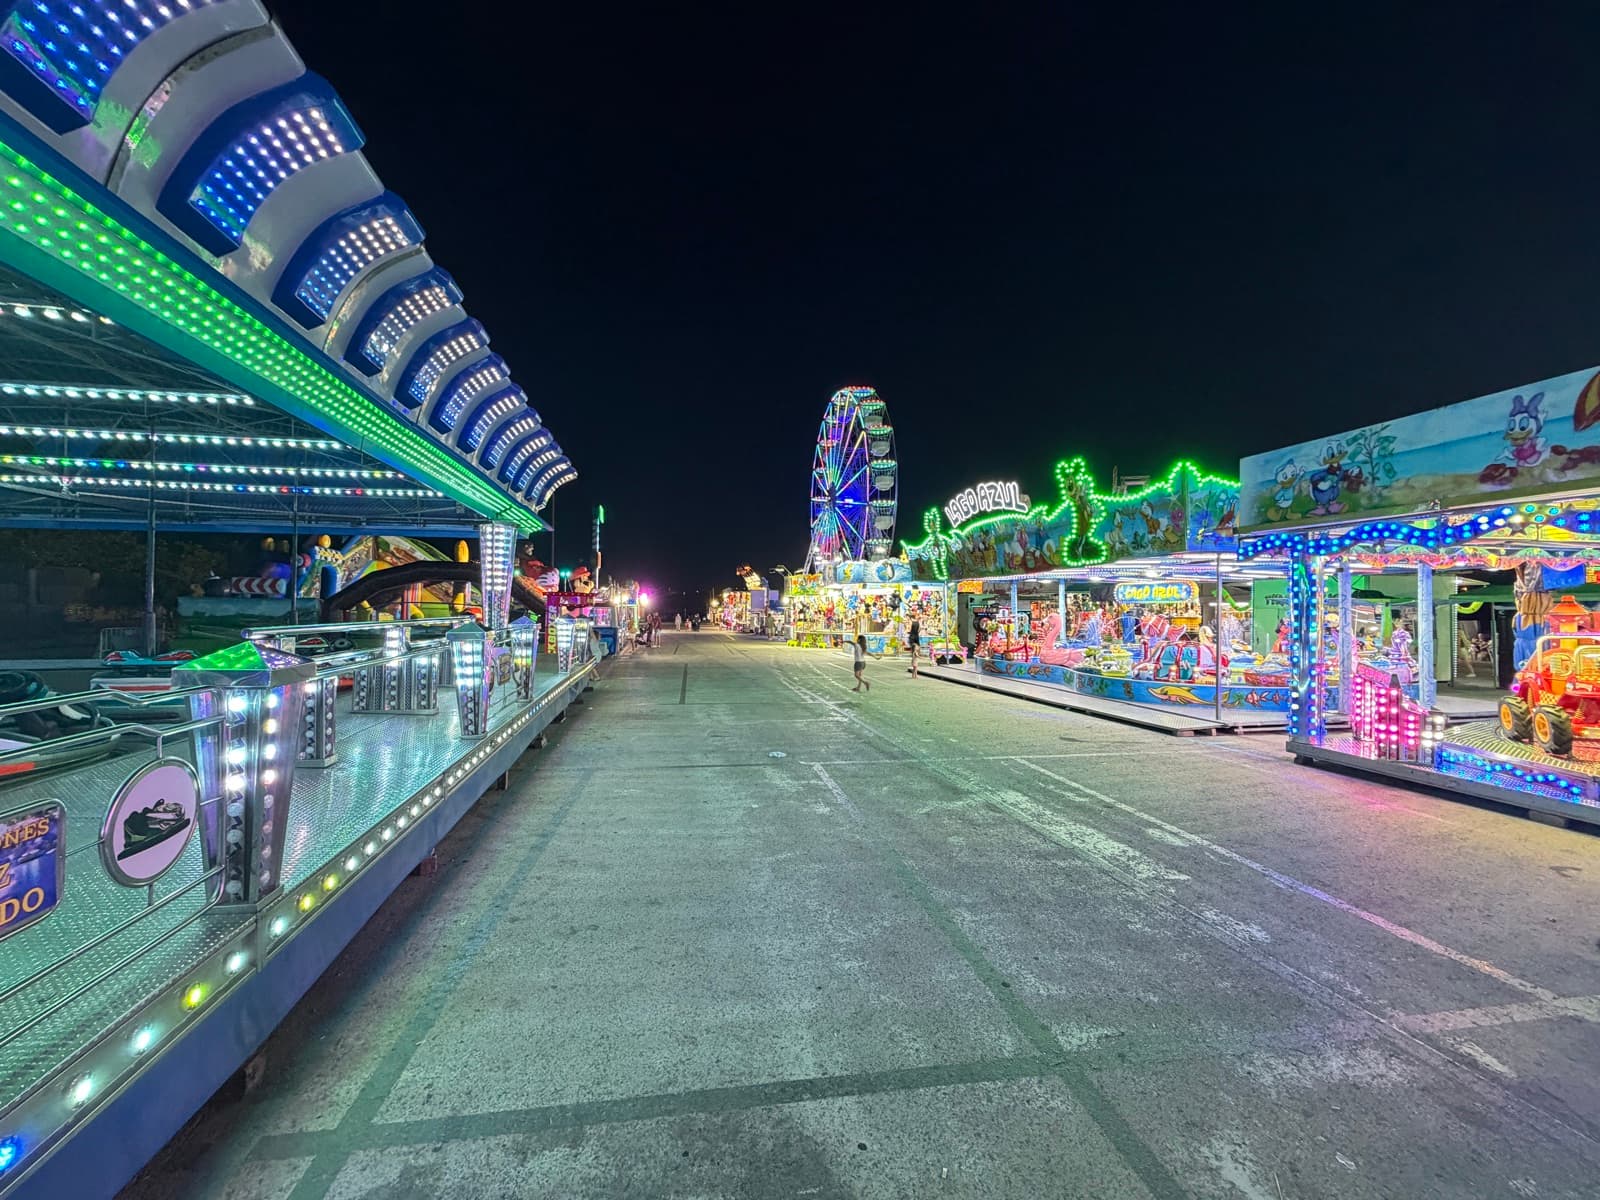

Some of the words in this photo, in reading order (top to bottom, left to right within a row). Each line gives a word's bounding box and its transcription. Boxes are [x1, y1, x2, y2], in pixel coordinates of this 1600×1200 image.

[944, 488, 979, 528] LAGO
[977, 481, 1029, 514] AZUL
[1152, 584, 1181, 600] AZUL
[0, 818, 50, 850] NES
